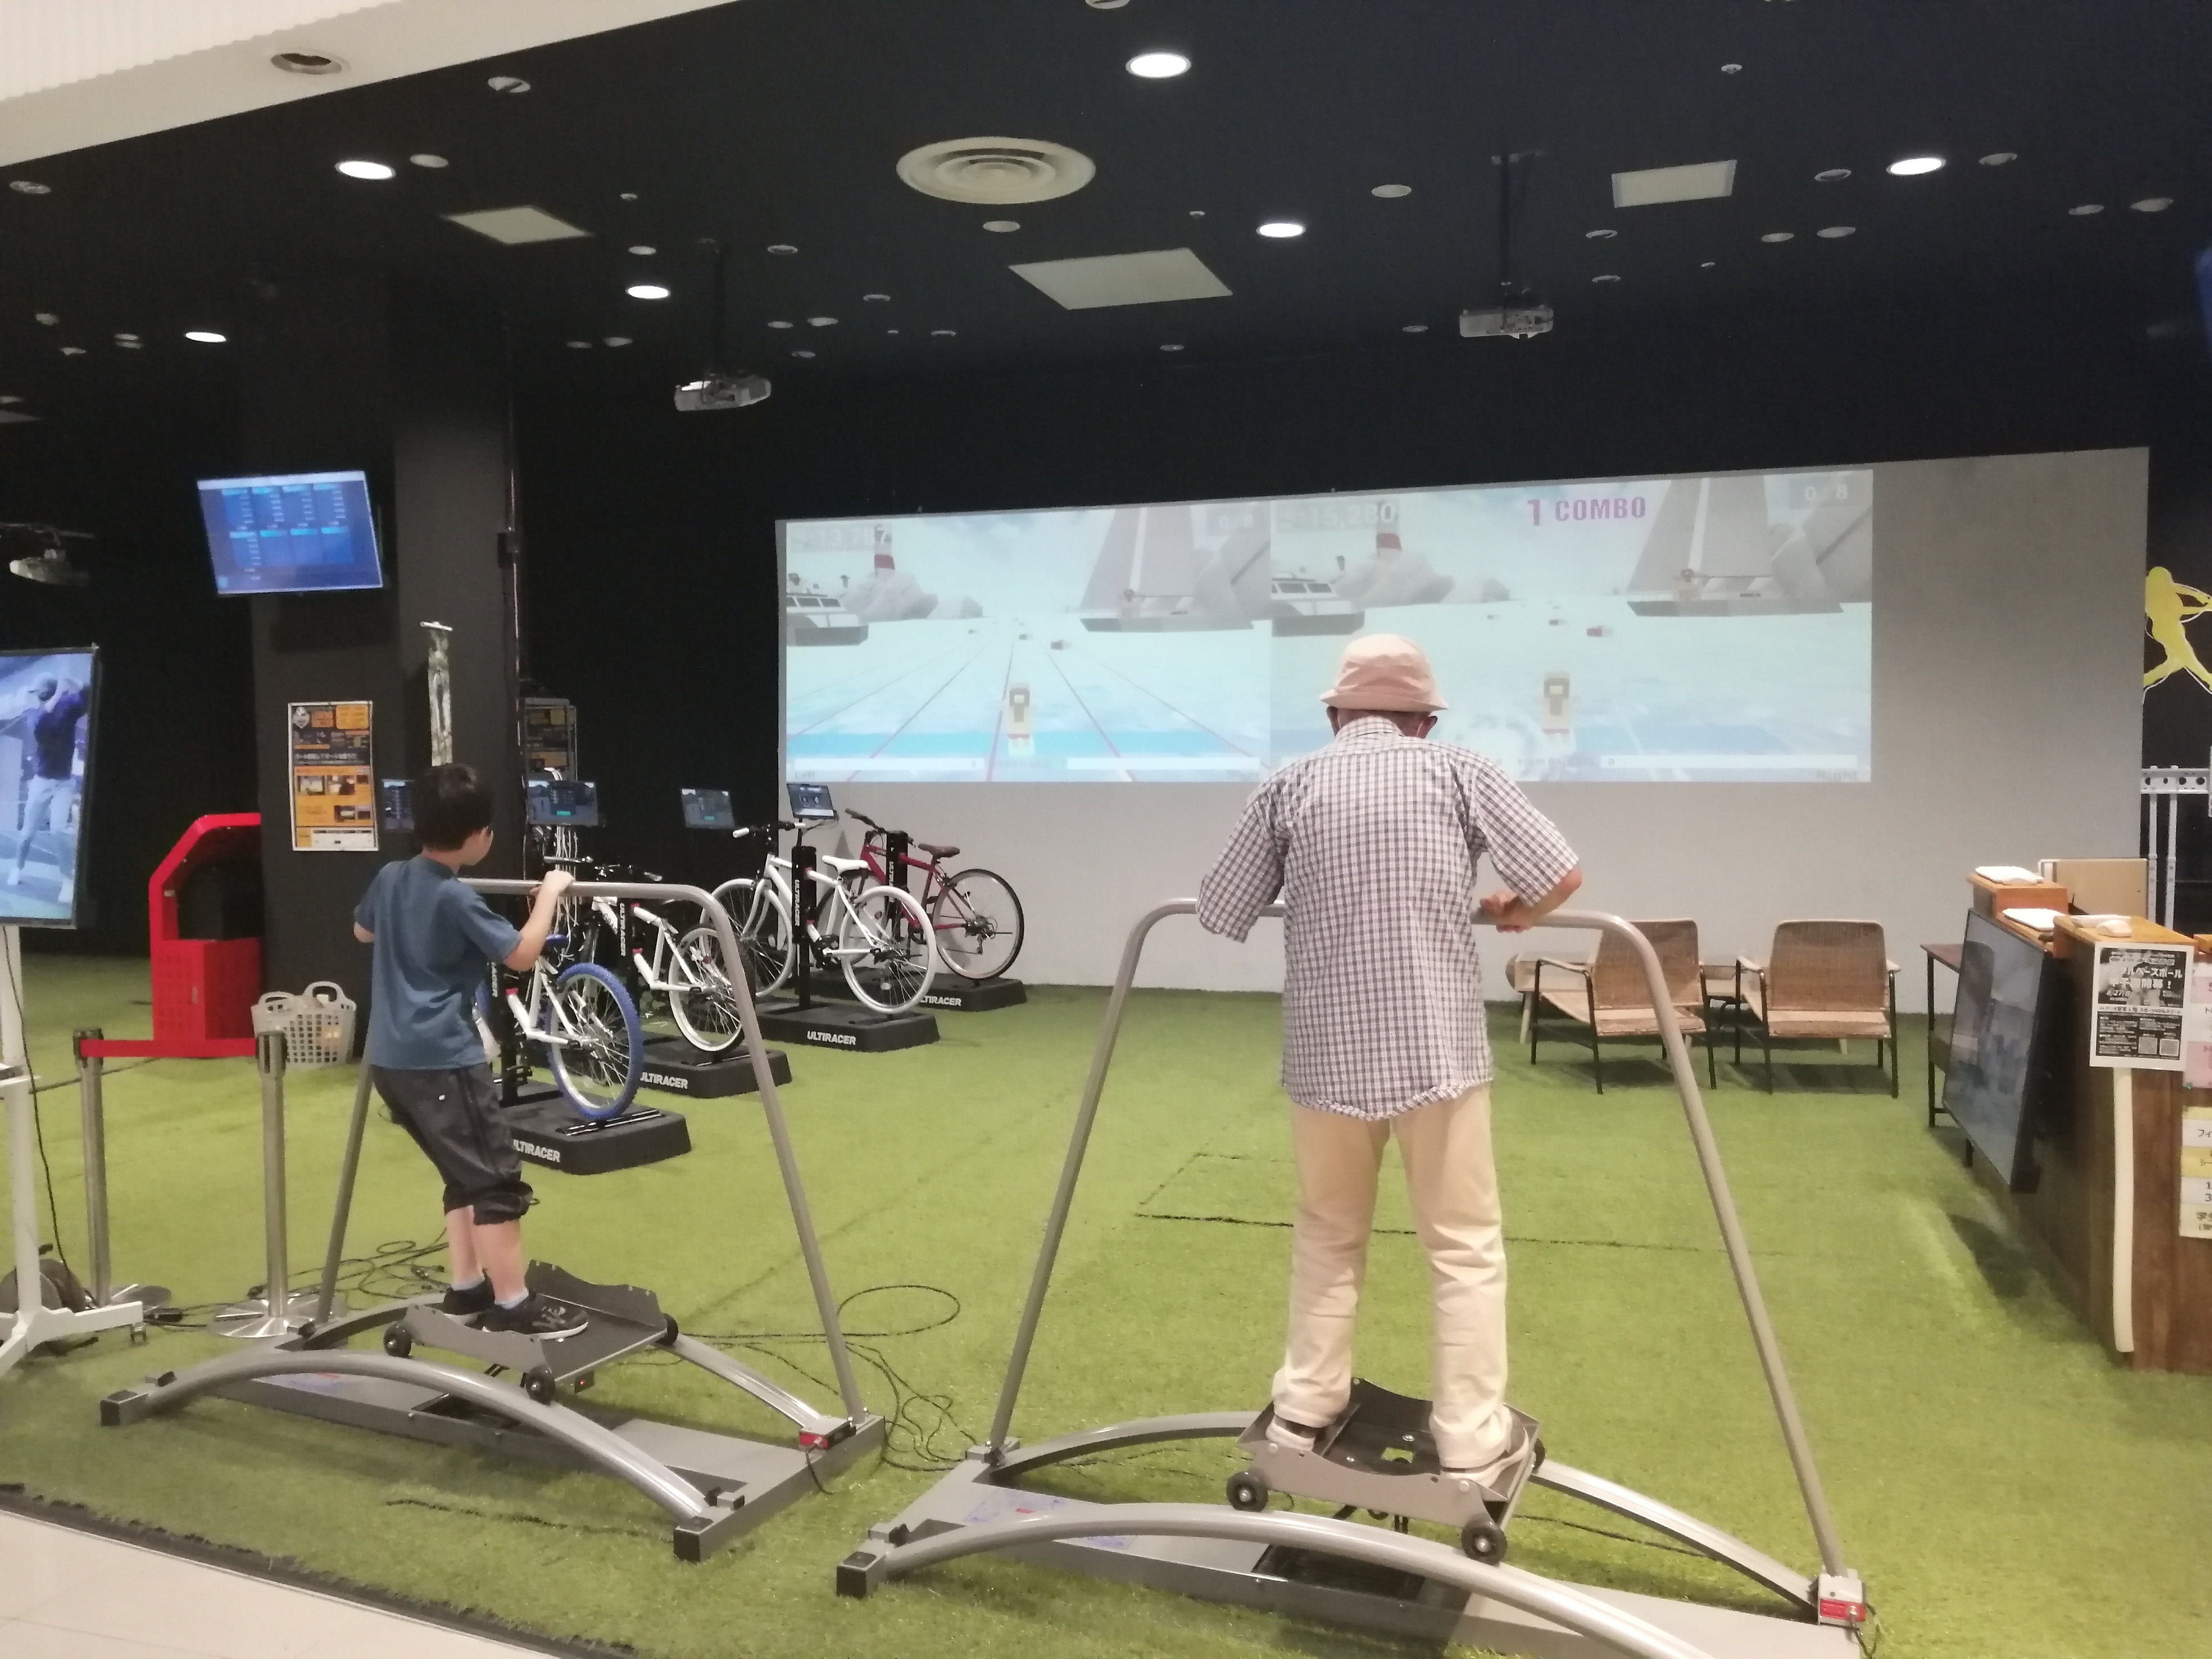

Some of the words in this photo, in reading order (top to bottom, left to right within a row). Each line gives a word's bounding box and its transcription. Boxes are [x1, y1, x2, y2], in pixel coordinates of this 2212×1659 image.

[1527, 499, 1540, 526] 1
[1555, 497, 1646, 522] COMBO
[920, 995, 962, 1007] TIRACER
[807, 1031, 856, 1045] ULTIRACER
